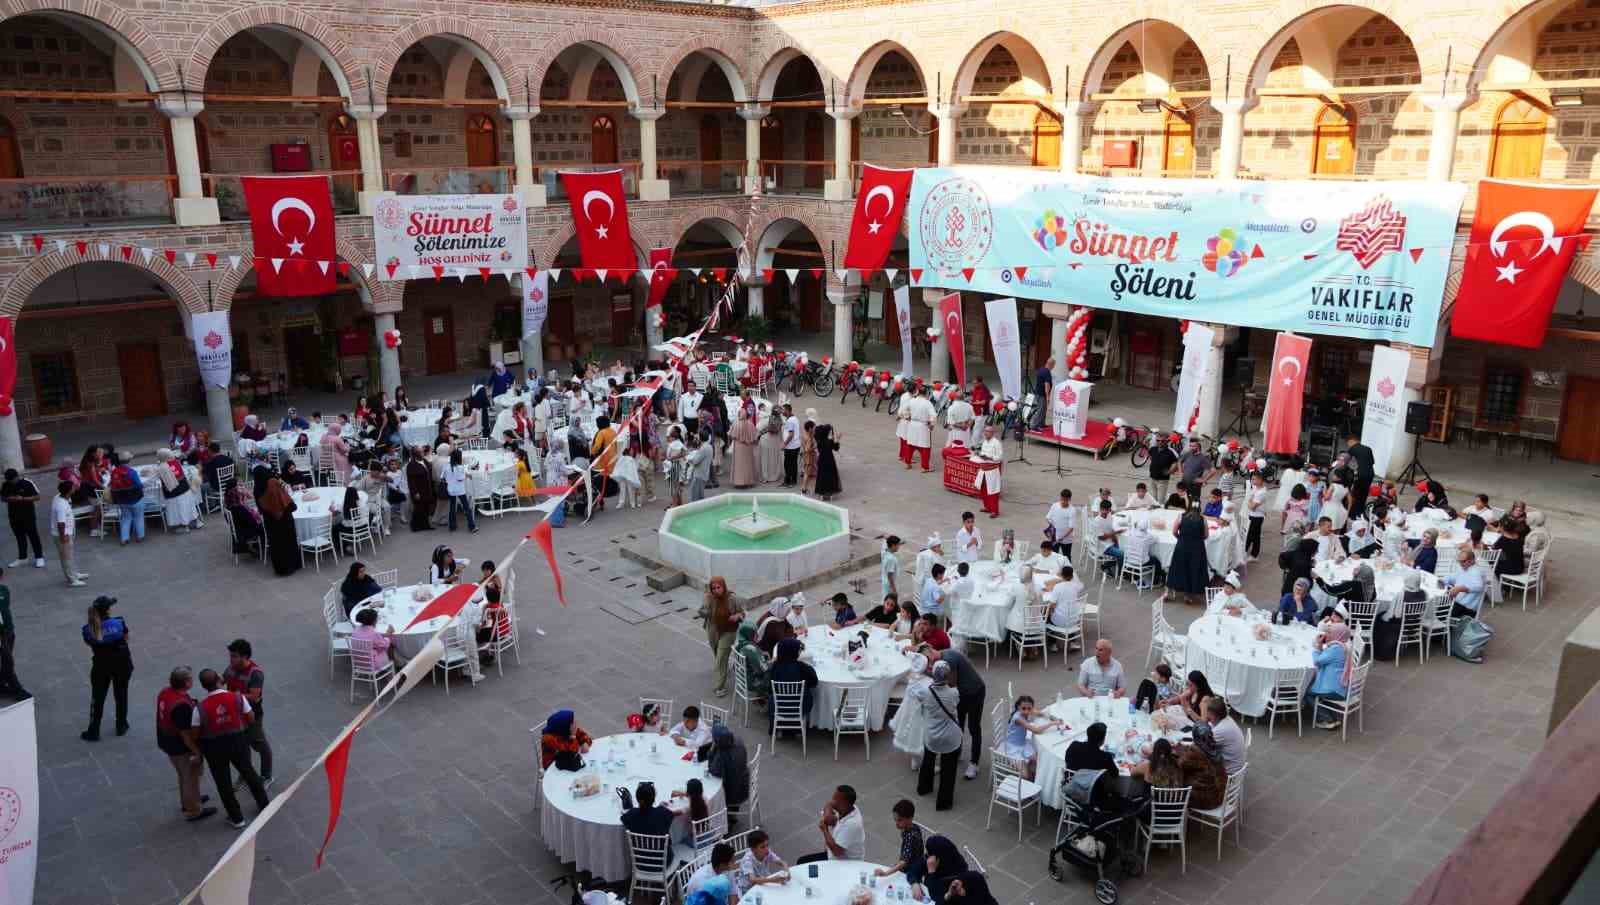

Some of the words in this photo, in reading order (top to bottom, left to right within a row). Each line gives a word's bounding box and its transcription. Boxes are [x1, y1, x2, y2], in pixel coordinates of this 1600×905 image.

[406, 211, 494, 237] Sünnet
[414, 234, 506, 256] Şölenimize
[1070, 218, 1180, 263] Sünnet
[419, 255, 442, 266] HOŞ
[444, 252, 492, 264] GELDİNİZ
[1110, 263, 1197, 301] Şöleni
[1311, 286, 1414, 314] VAKIFLAR
[1307, 310, 1341, 323] GENEL
